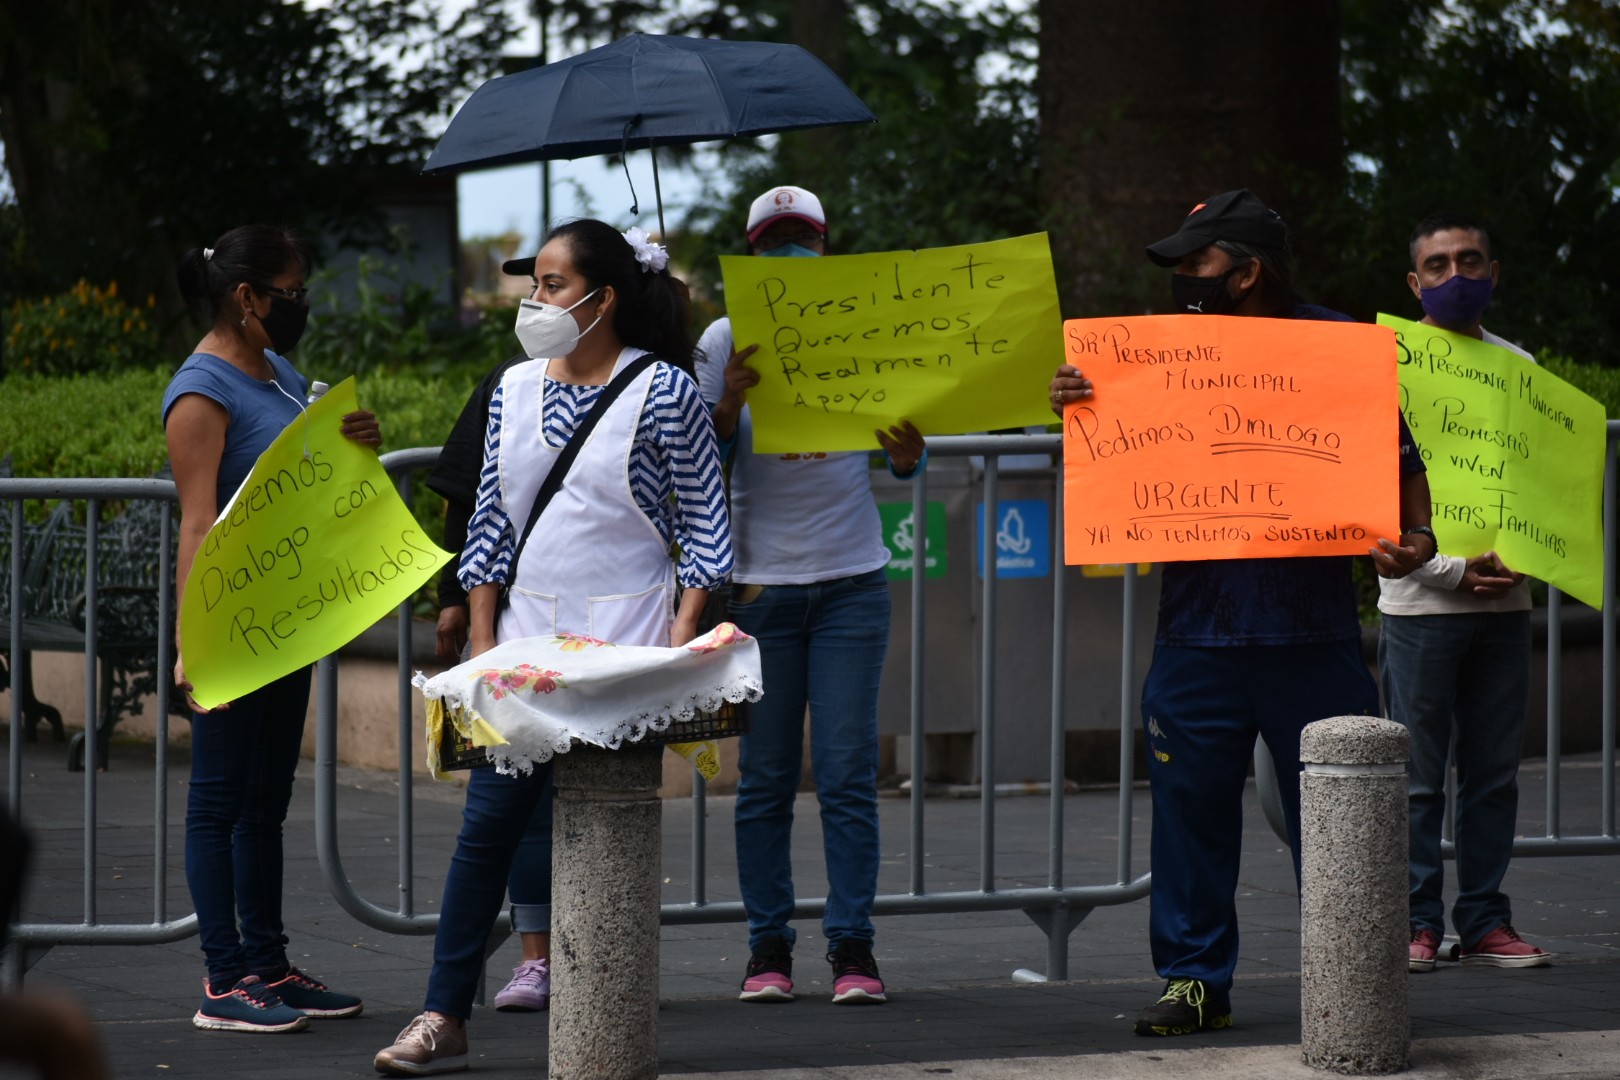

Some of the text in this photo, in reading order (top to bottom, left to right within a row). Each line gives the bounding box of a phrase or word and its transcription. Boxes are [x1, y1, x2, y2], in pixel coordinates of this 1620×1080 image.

[773, 312, 971, 354] Queremos
[780, 333, 1008, 385] Realmente
[1165, 369, 1301, 393] MUNICIPAL
[1133, 479, 1285, 510] URGENTE
[200, 479, 378, 614] Dialogo con
[1085, 524, 1366, 546] YA NO TENEMOS SUSTENTO
